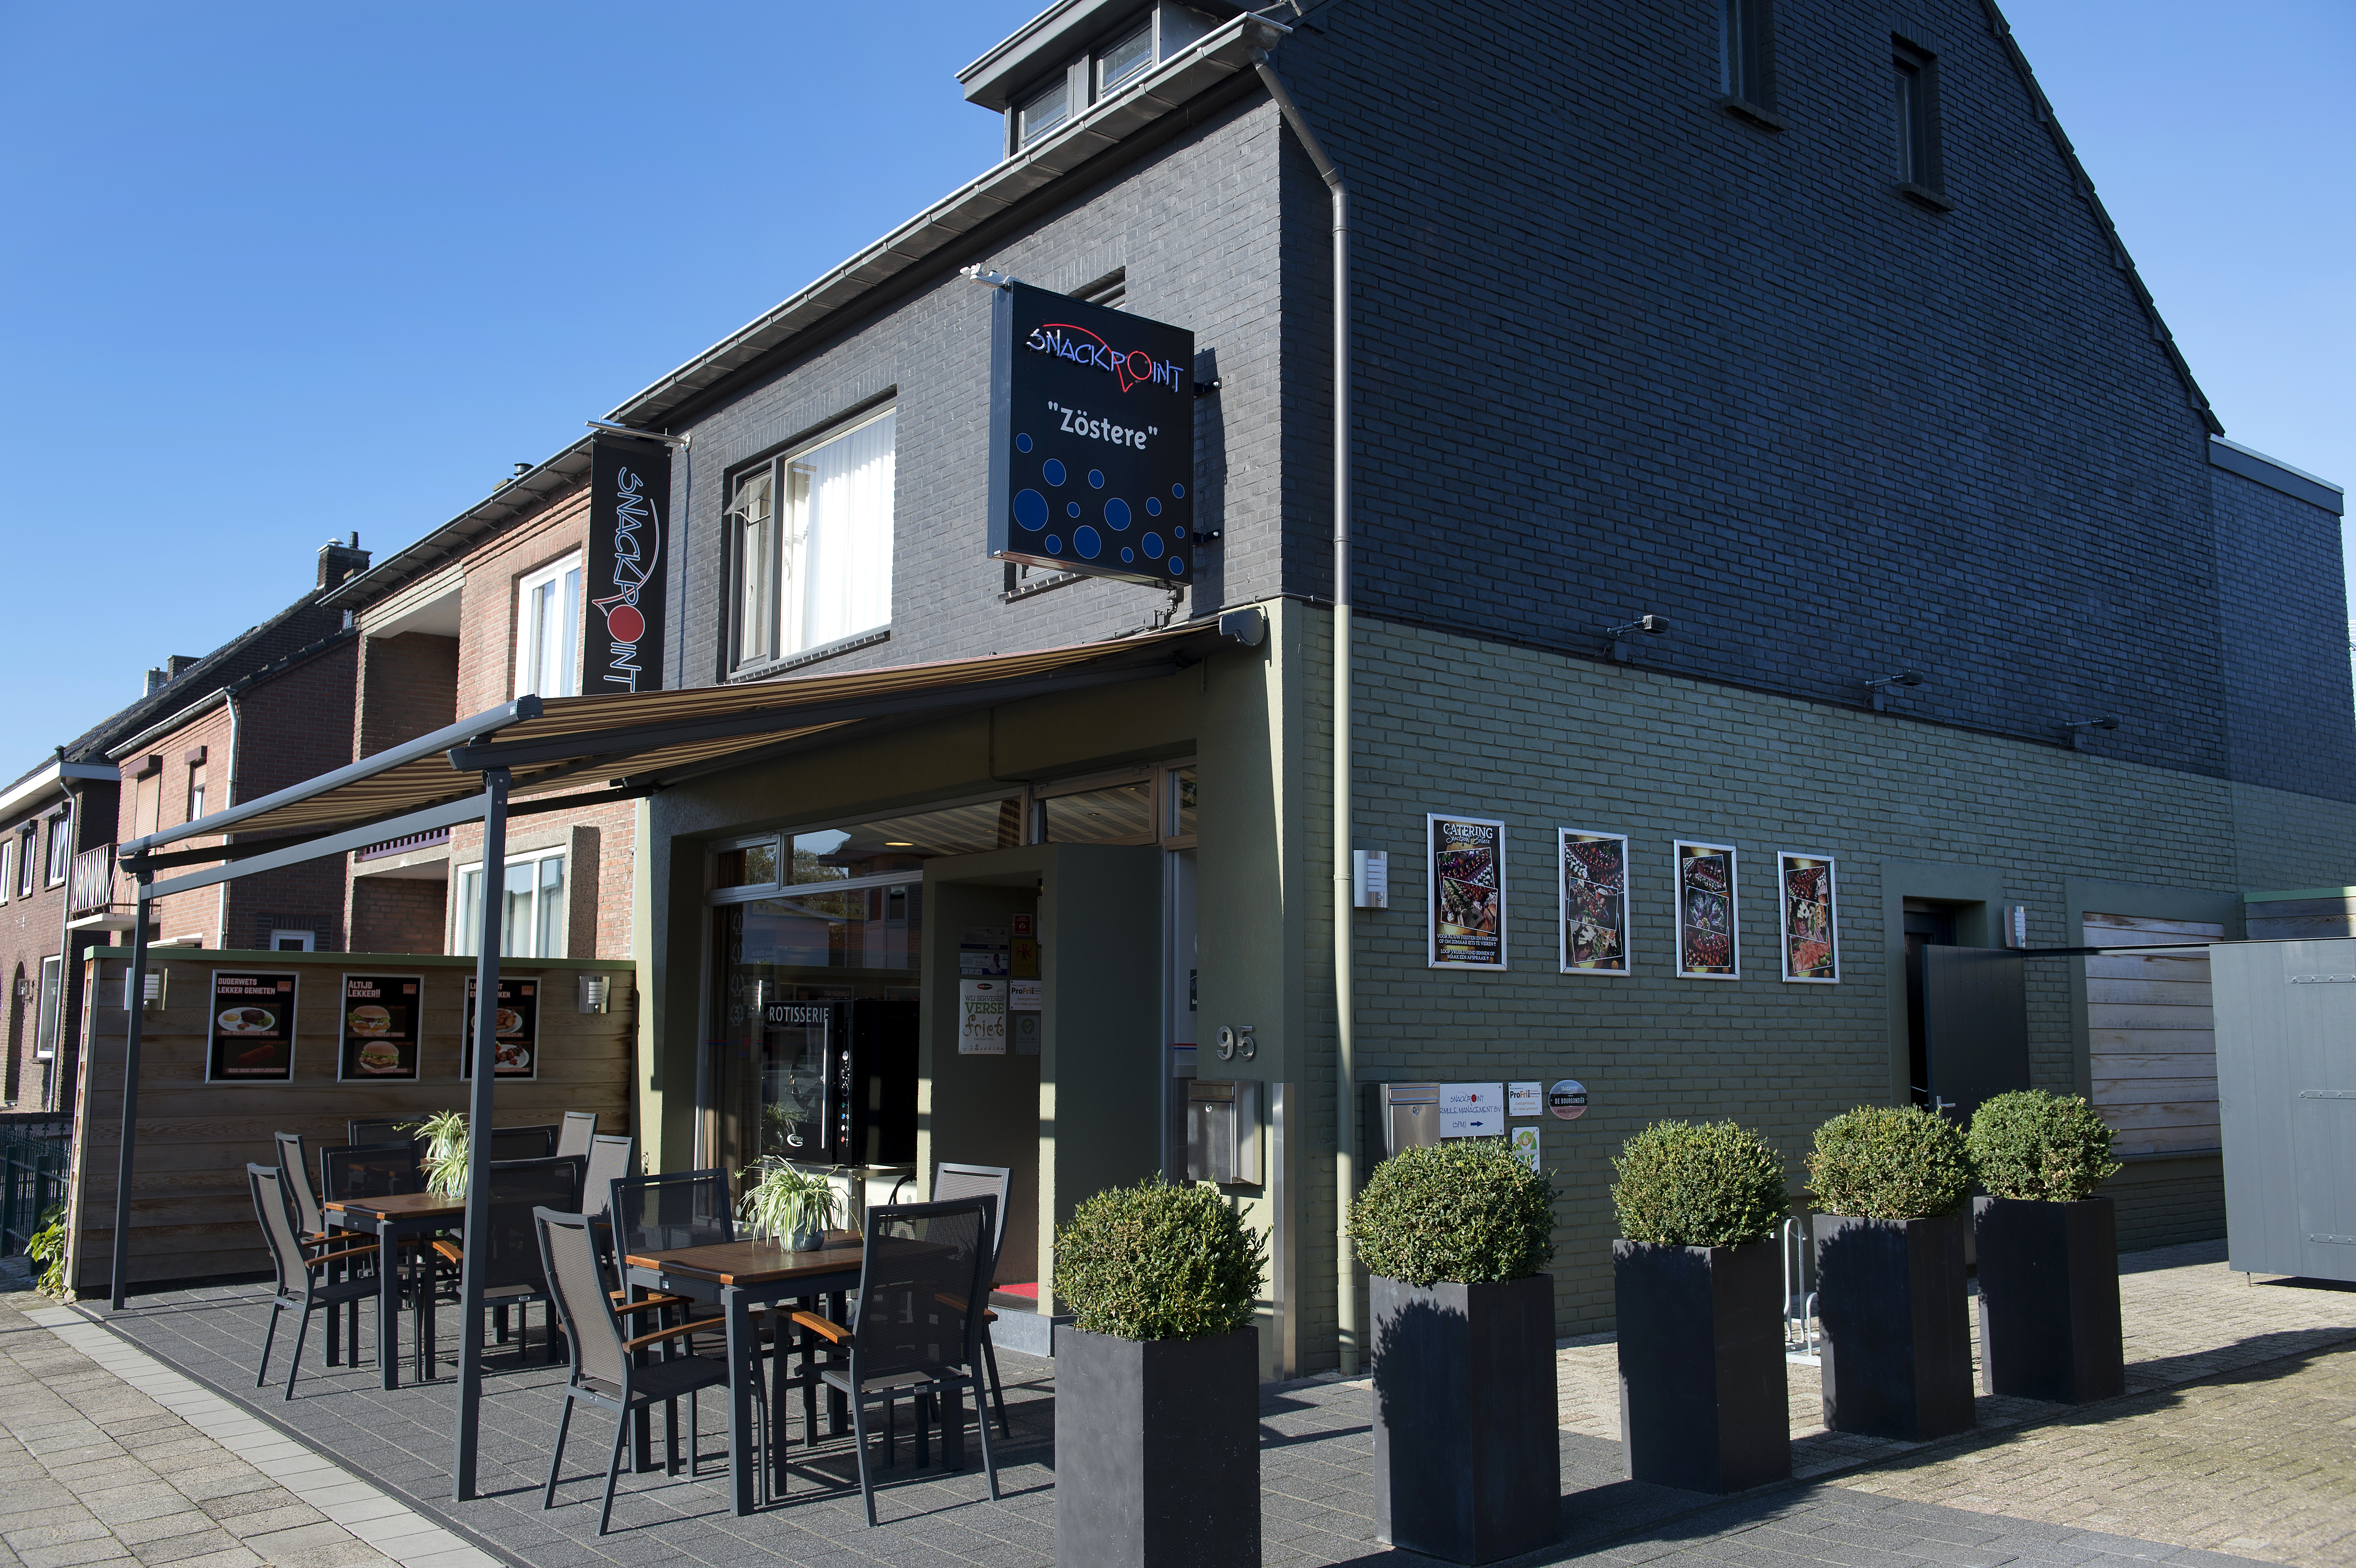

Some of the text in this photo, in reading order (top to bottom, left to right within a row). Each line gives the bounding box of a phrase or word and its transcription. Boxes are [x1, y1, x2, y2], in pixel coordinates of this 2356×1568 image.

[1026, 326, 1184, 393] SNACKPOINT
[1048, 400, 1158, 450] "Zöstere"
[601, 467, 651, 693] SNACKPOINT
[1443, 823, 1493, 839] CATERING
[348, 980, 373, 989] ALTIJD
[348, 989, 381, 998] LEKKER!!
[769, 1006, 829, 1023] ROTISSERIE
[964, 1002, 1004, 1014] VERSE
[962, 1014, 1004, 1037] friet
[1216, 1025, 1254, 1061] 95
[1450, 1093, 1484, 1104] SNACKPOINT
[1459, 1105, 1493, 1115] MANAGEMENT
[1452, 1121, 1466, 1129] (SFM)
